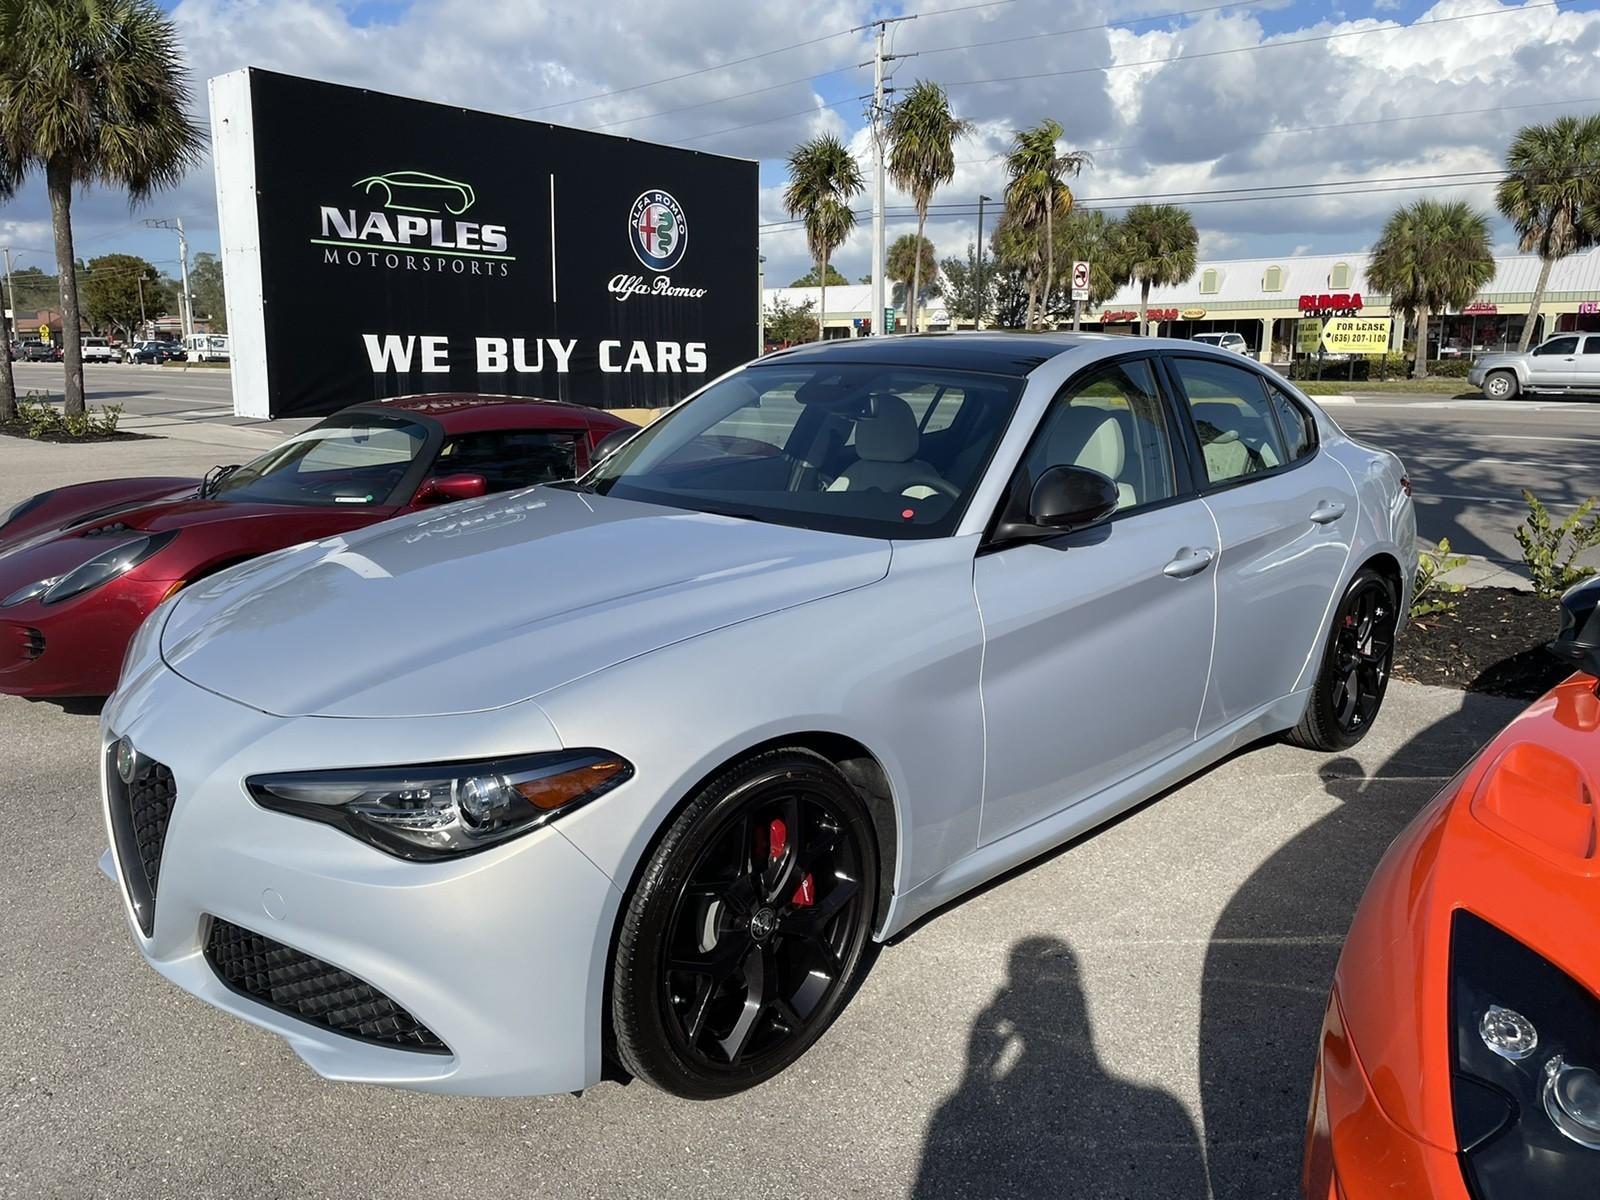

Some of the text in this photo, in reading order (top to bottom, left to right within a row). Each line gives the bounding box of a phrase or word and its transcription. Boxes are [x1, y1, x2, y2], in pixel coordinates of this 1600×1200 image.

[631, 193, 685, 235] ALFA ROMEO
[320, 205, 508, 253] NAPLES
[323, 248, 509, 277] MOTORSPORTS
[607, 273, 708, 302] Alfa Romeo
[1298, 293, 1363, 312] RUMBA
[1337, 323, 1385, 331] FOR LEASE
[1352, 334, 1386, 342] 207-1100
[363, 334, 707, 373] WE BUY CARS
